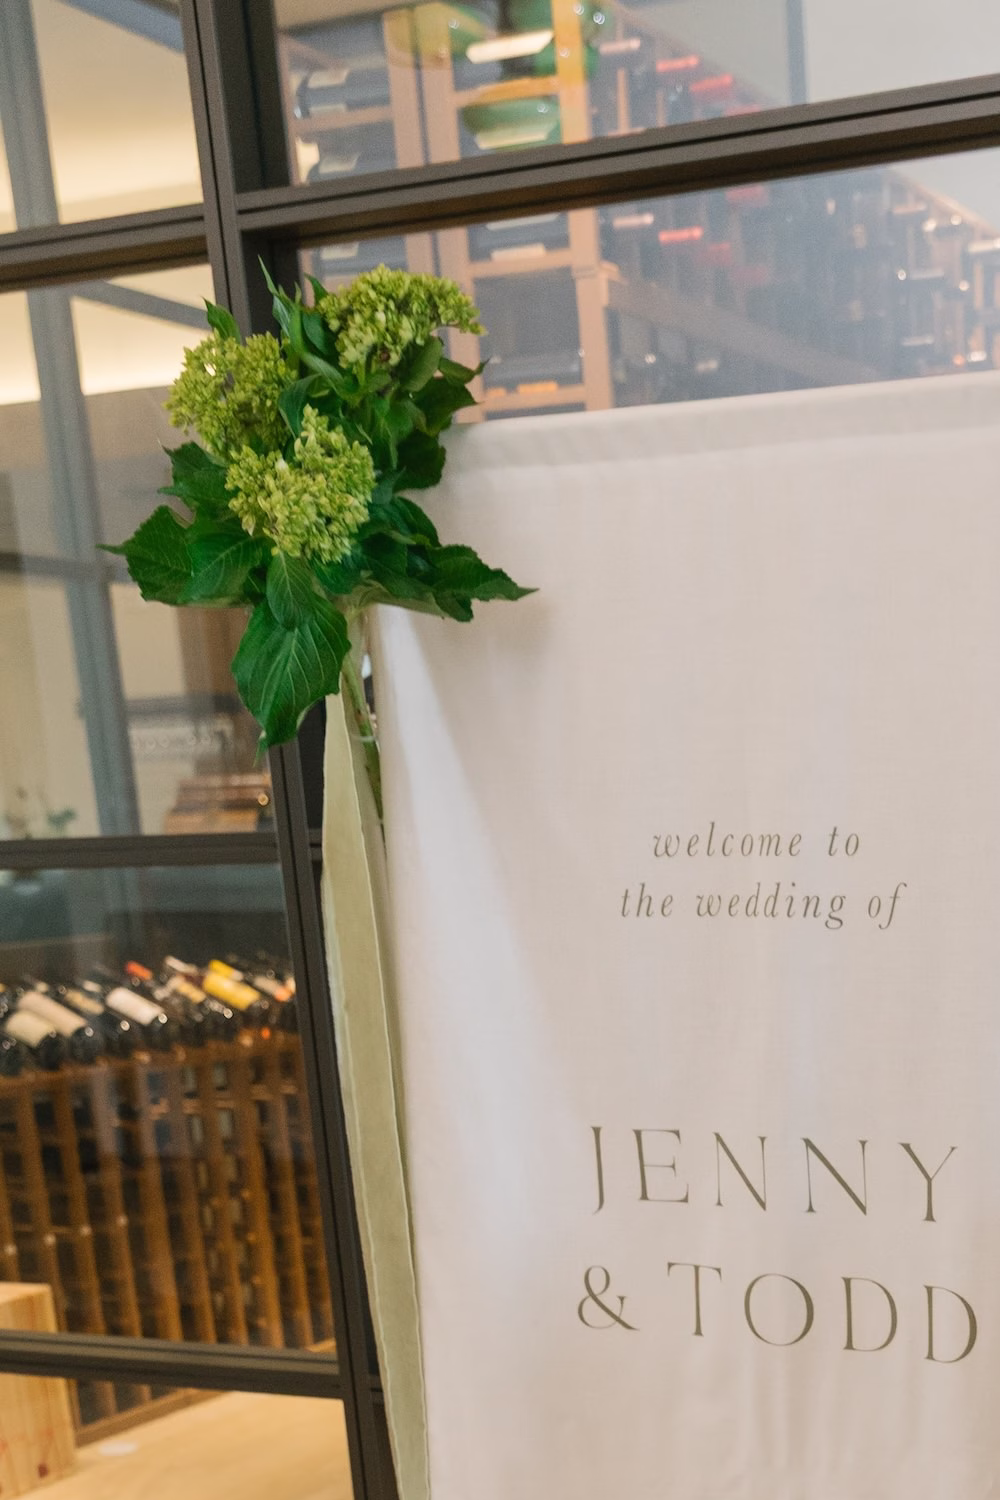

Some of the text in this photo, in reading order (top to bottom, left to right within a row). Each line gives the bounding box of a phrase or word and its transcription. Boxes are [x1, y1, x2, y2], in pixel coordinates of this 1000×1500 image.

[652, 821, 861, 858] welcome to
[620, 881, 908, 930] the wedding of
[590, 1125, 958, 1222] JENNY
[577, 1261, 978, 1364] & TODD
